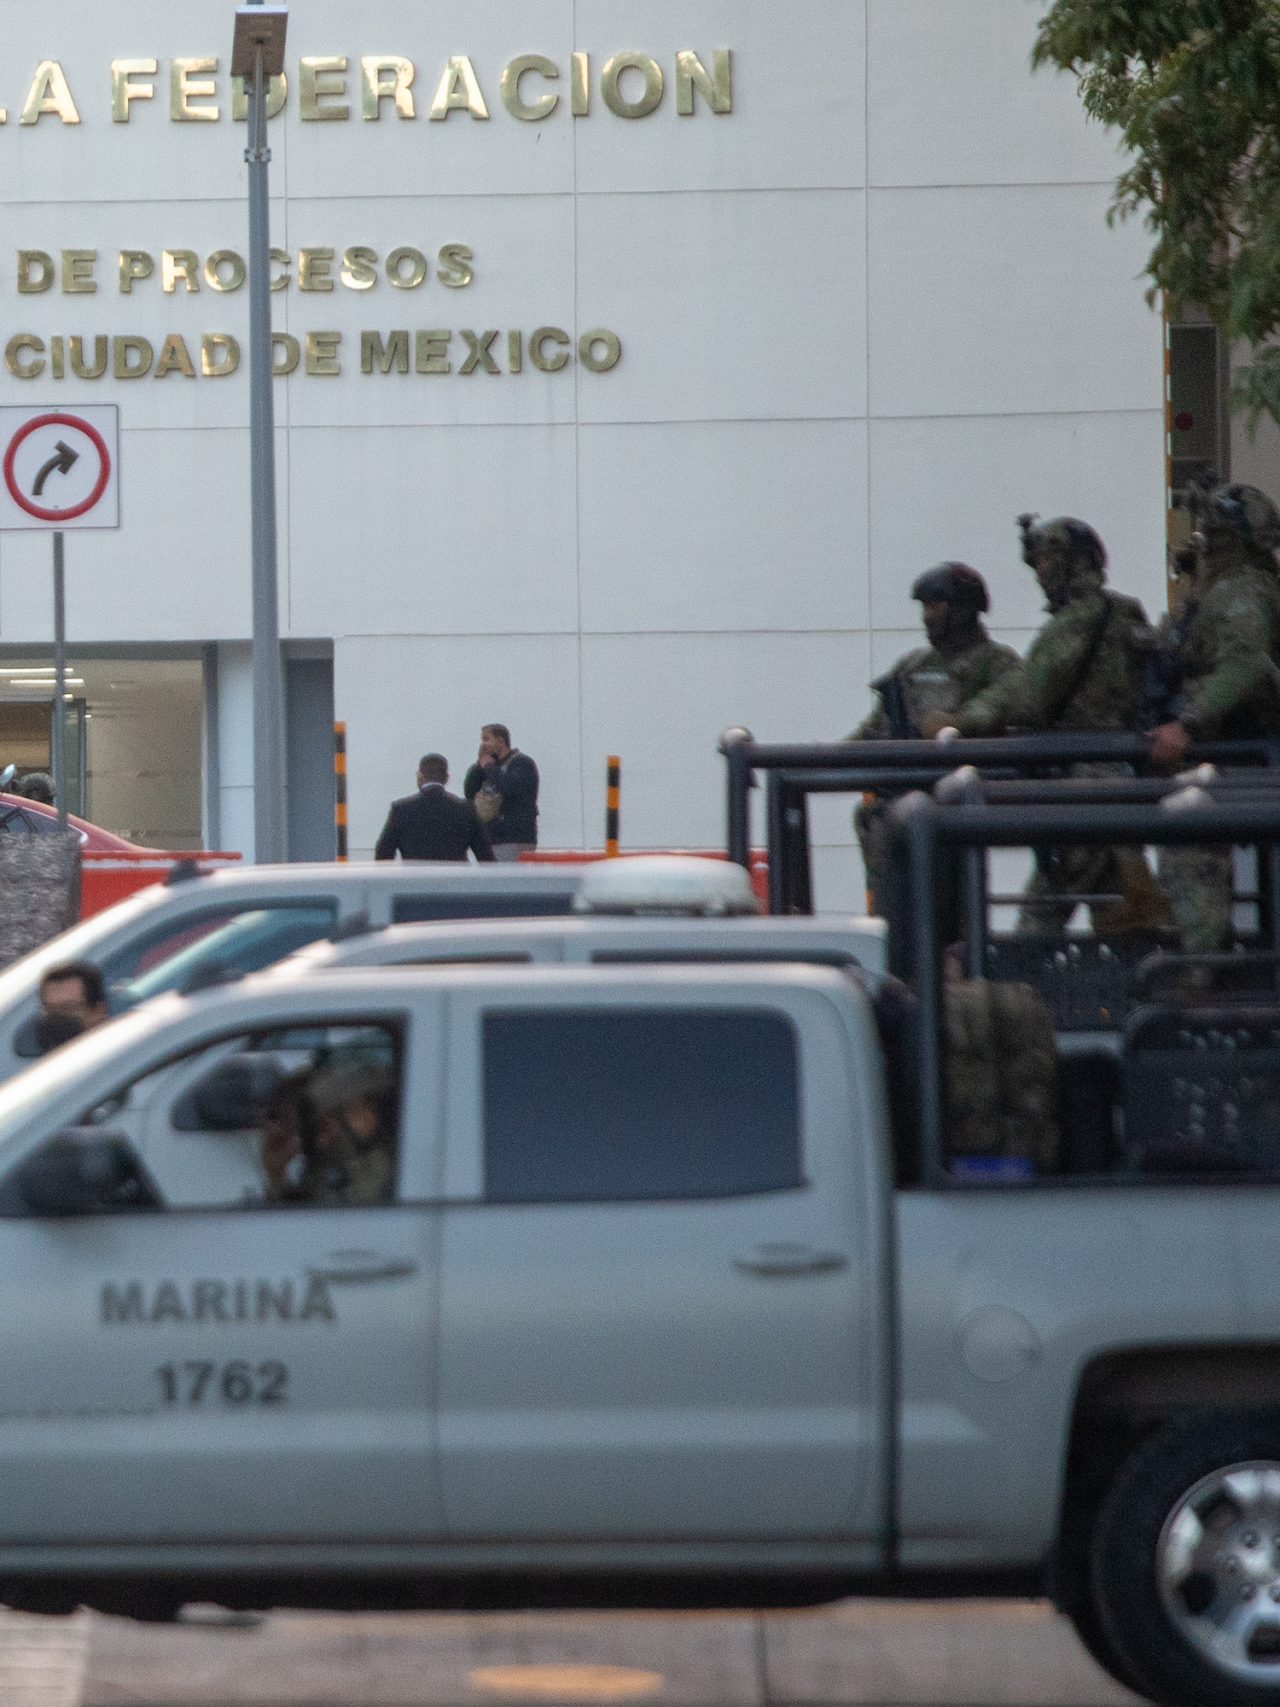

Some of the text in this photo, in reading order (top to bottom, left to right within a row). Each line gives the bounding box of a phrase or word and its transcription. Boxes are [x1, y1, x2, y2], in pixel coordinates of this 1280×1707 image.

[109, 47, 735, 123] FEDERACION
[16, 248, 97, 294] DE
[3, 332, 241, 380] CIUDAD
[271, 331, 342, 377] DE
[360, 326, 622, 376] MEXICO
[99, 1272, 337, 1324] MARINA
[155, 1358, 289, 1407] 1762
